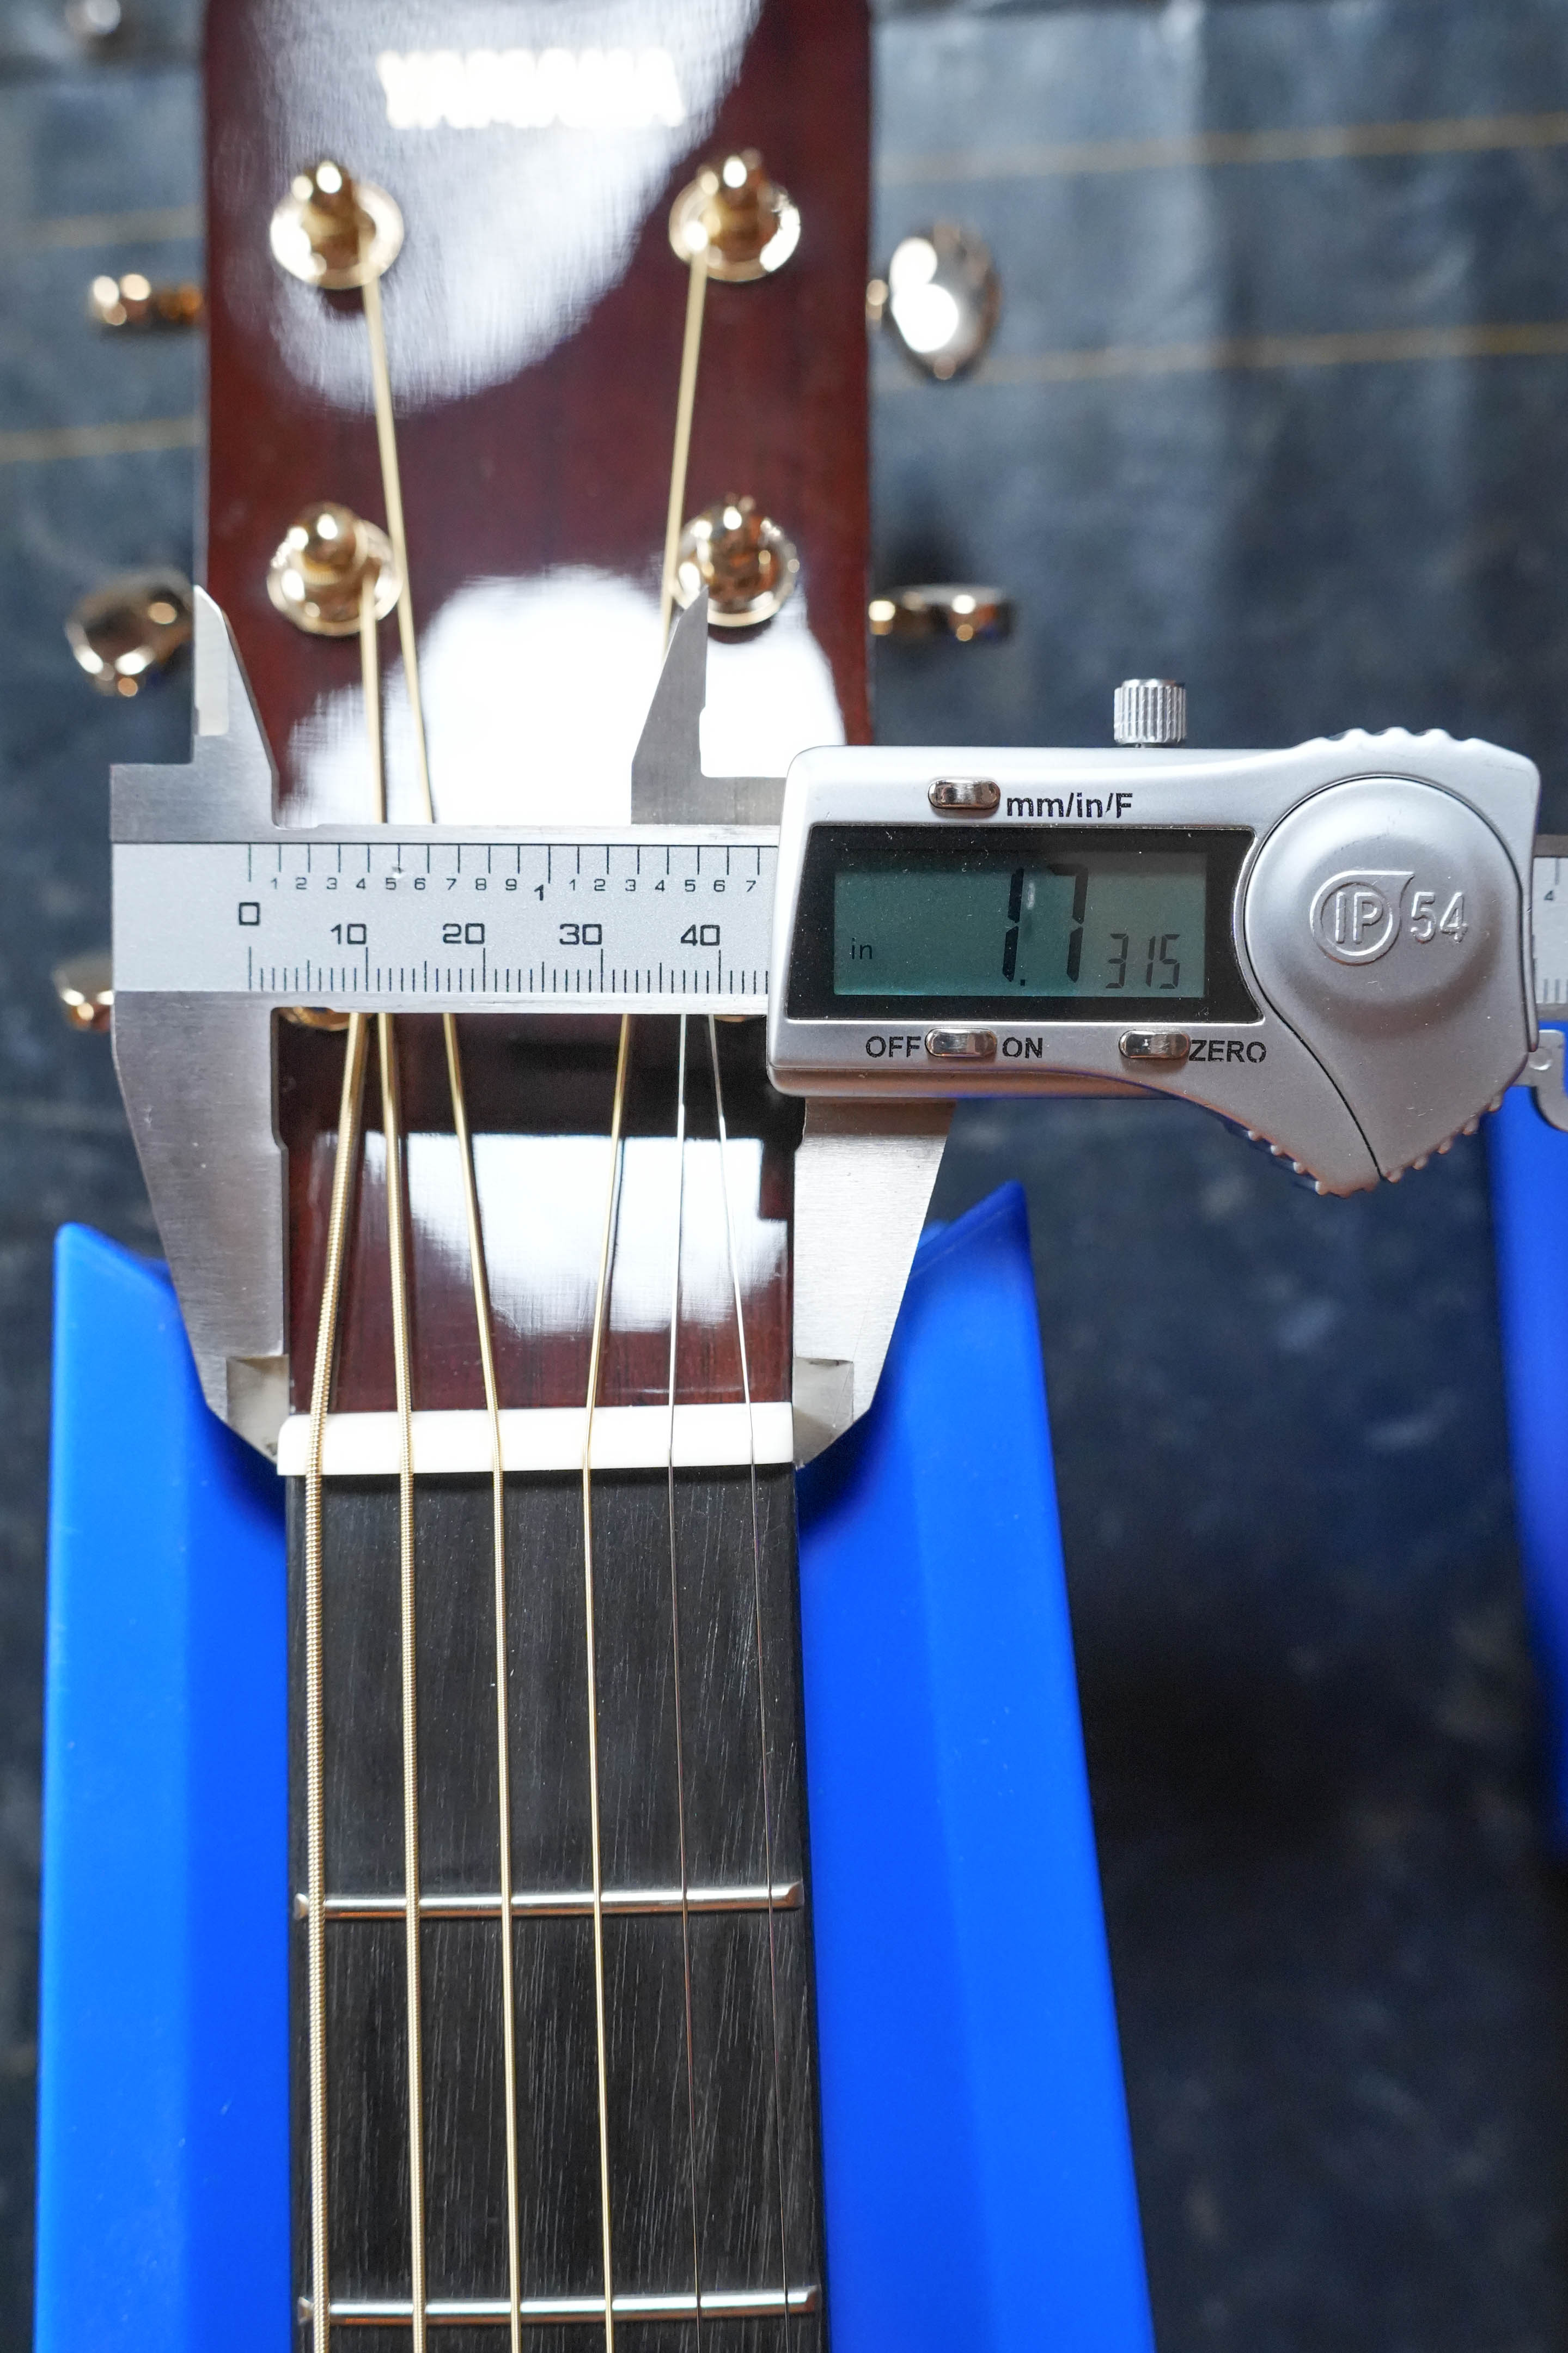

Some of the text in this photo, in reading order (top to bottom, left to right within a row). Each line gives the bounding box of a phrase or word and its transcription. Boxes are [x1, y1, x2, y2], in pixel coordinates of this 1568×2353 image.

[1006, 792, 1133, 819] mm/in/F
[270, 877, 756, 901] 1 2 3 4 5 6 7 8 9 1 1 2 3 4 5 6 7
[1543, 890, 1554, 902] 4
[330, 923, 721, 946] 10 20 30 40
[850, 938, 873, 960] in
[865, 1036, 922, 1058] OFF
[1002, 1037, 1043, 1059] ON
[1187, 1038, 1267, 1063] ZERO
